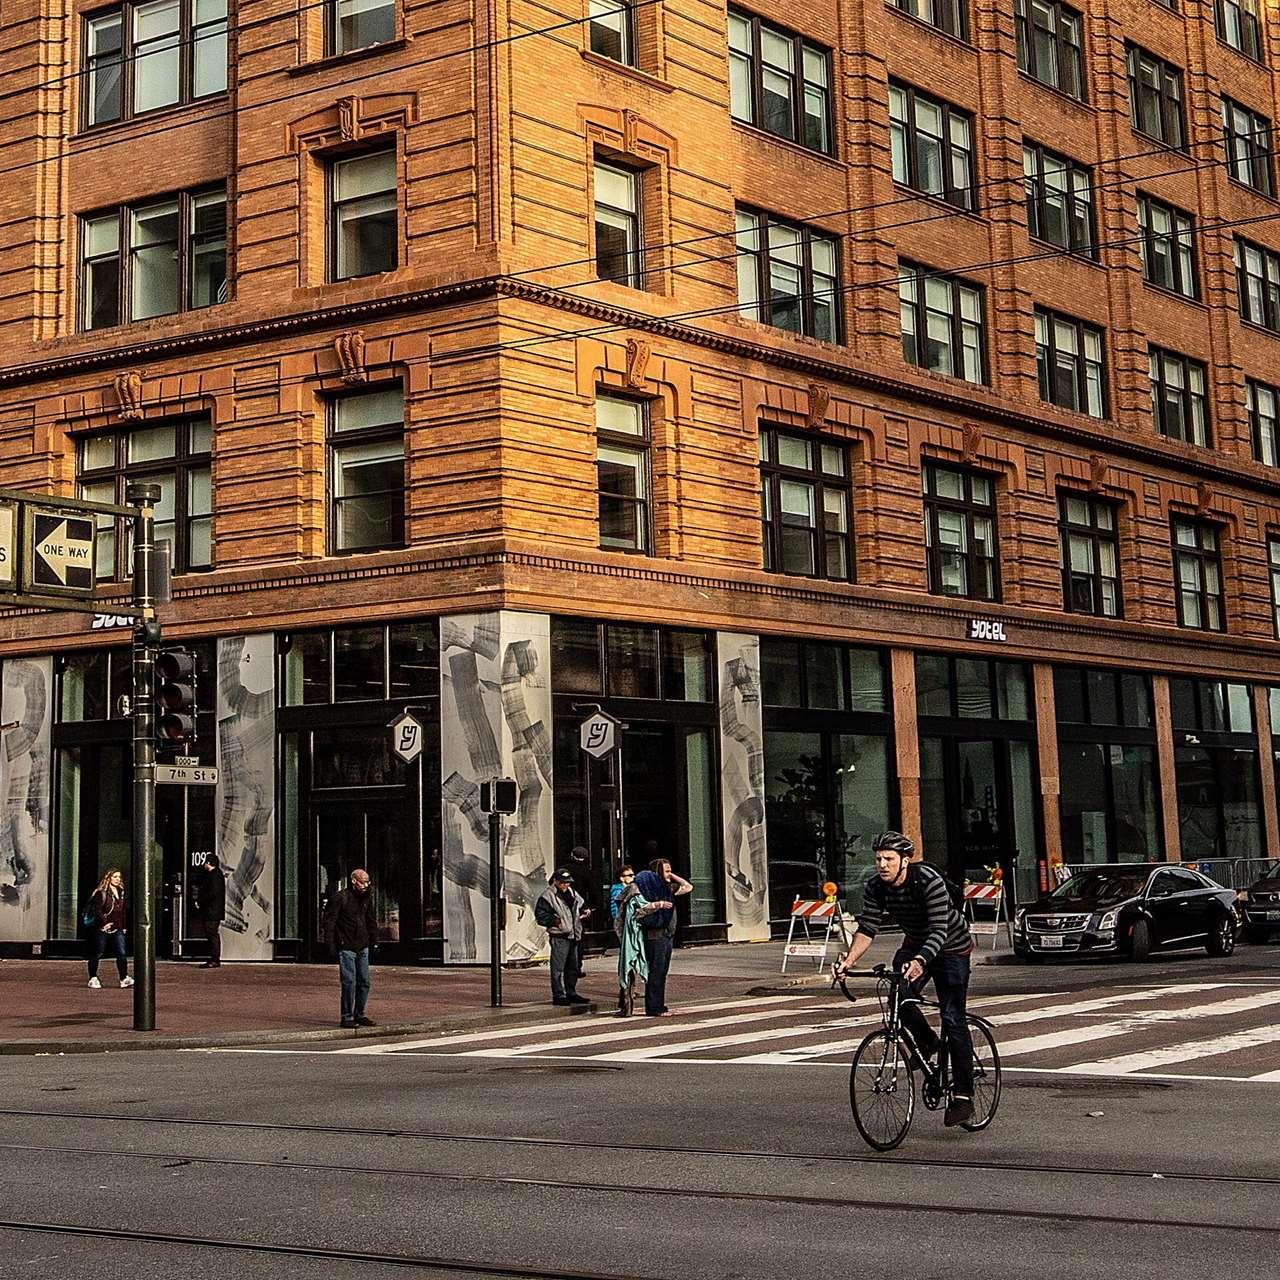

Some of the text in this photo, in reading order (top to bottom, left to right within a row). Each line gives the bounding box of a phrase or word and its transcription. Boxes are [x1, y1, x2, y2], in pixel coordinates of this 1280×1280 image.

[43, 544, 89, 559] ONE WAY
[169, 769, 206, 781] 7th St
